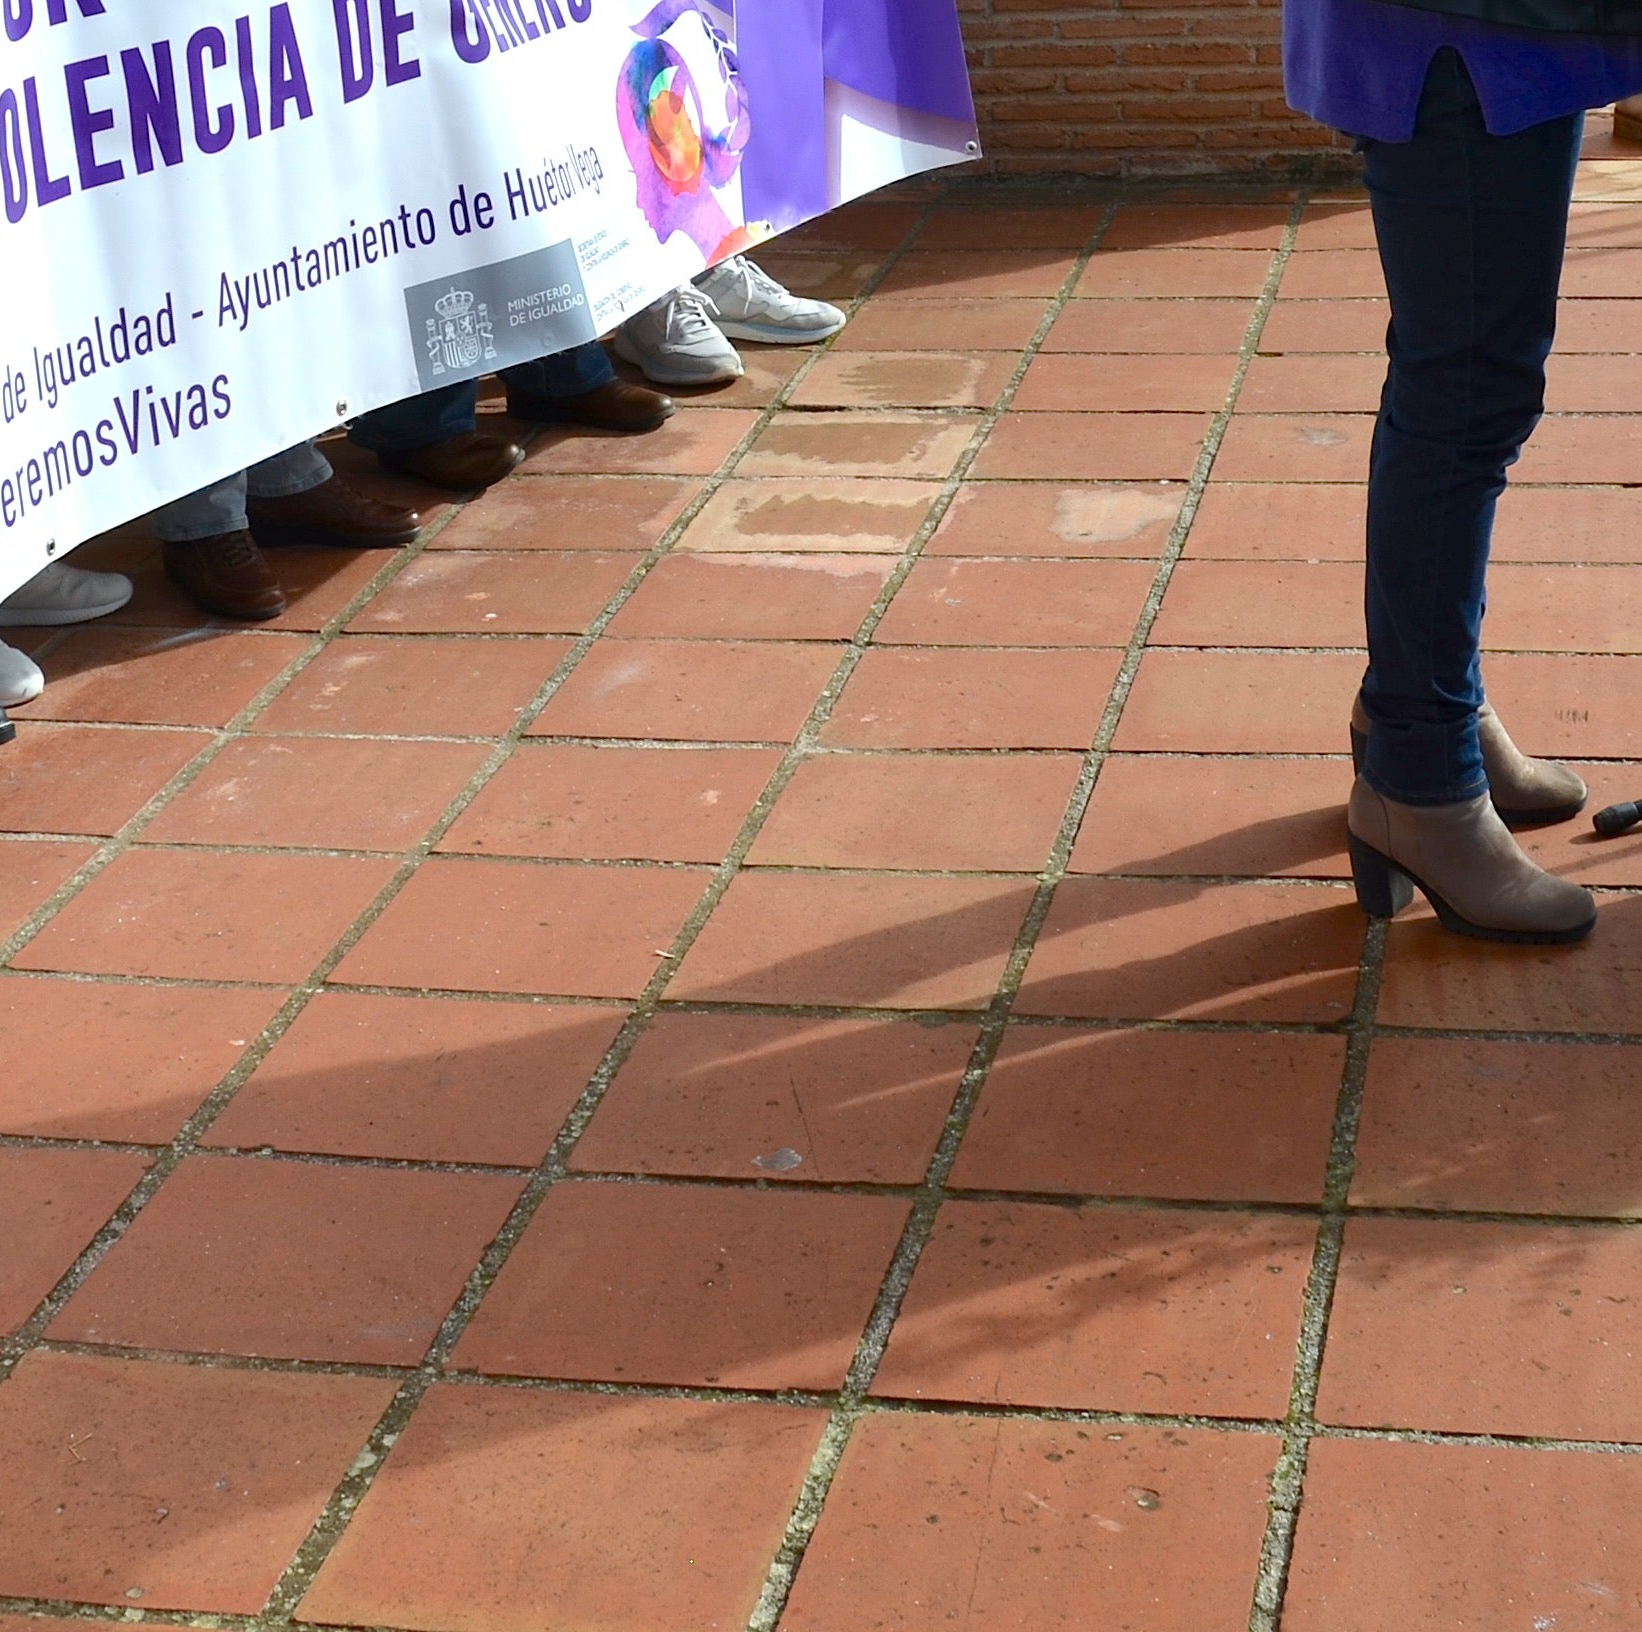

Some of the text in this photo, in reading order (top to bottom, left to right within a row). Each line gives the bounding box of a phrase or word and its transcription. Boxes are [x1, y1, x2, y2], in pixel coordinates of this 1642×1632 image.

[3, 365, 27, 424] de
[34, 291, 176, 409] Igualdad
[218, 203, 437, 332] Ayuntamiento
[449, 183, 495, 237] de
[504, 156, 572, 221] Huétor
[566, 144, 604, 196] Vega
[507, 283, 572, 313] MINISTERIO
[509, 313, 527, 327] DE
[528, 293, 585, 323] IGUALDAD
